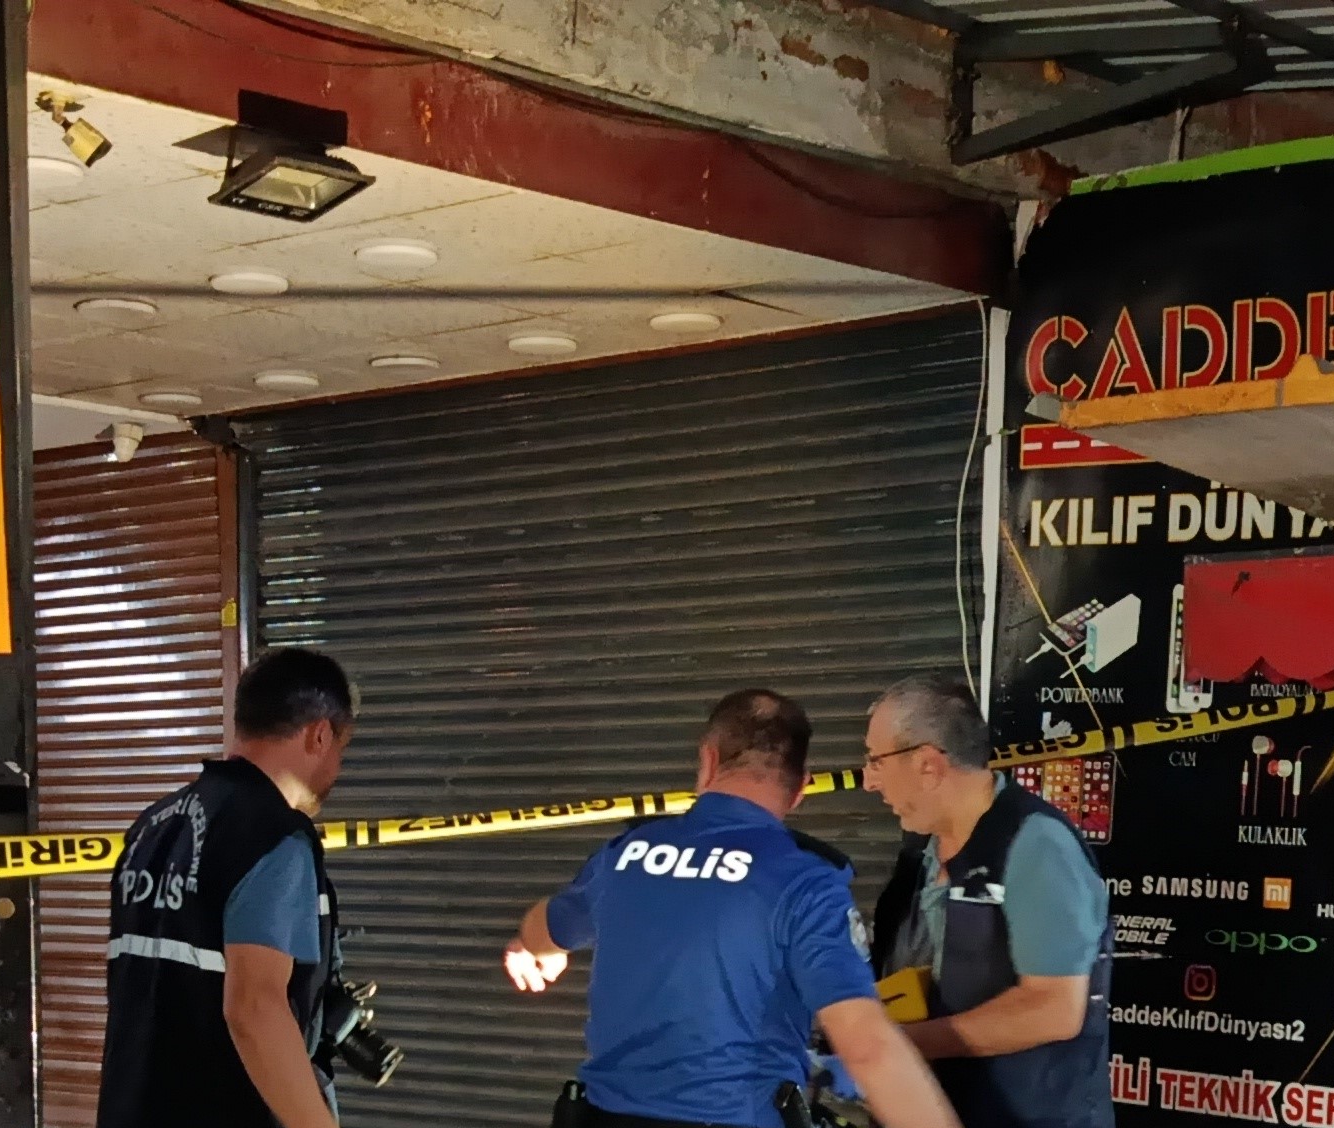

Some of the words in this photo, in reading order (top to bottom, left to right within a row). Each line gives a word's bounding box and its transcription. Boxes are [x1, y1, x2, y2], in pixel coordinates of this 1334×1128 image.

[1029, 494, 1156, 547] KILIF
[1238, 825, 1308, 846] KULAKLIK
[1100, 877, 1132, 896] ne
[1141, 875, 1250, 901] SAMSUNG
[1107, 1002, 1307, 1042] addeKılıfDünyası2
[1156, 1069, 1283, 1125] TEKNİK
